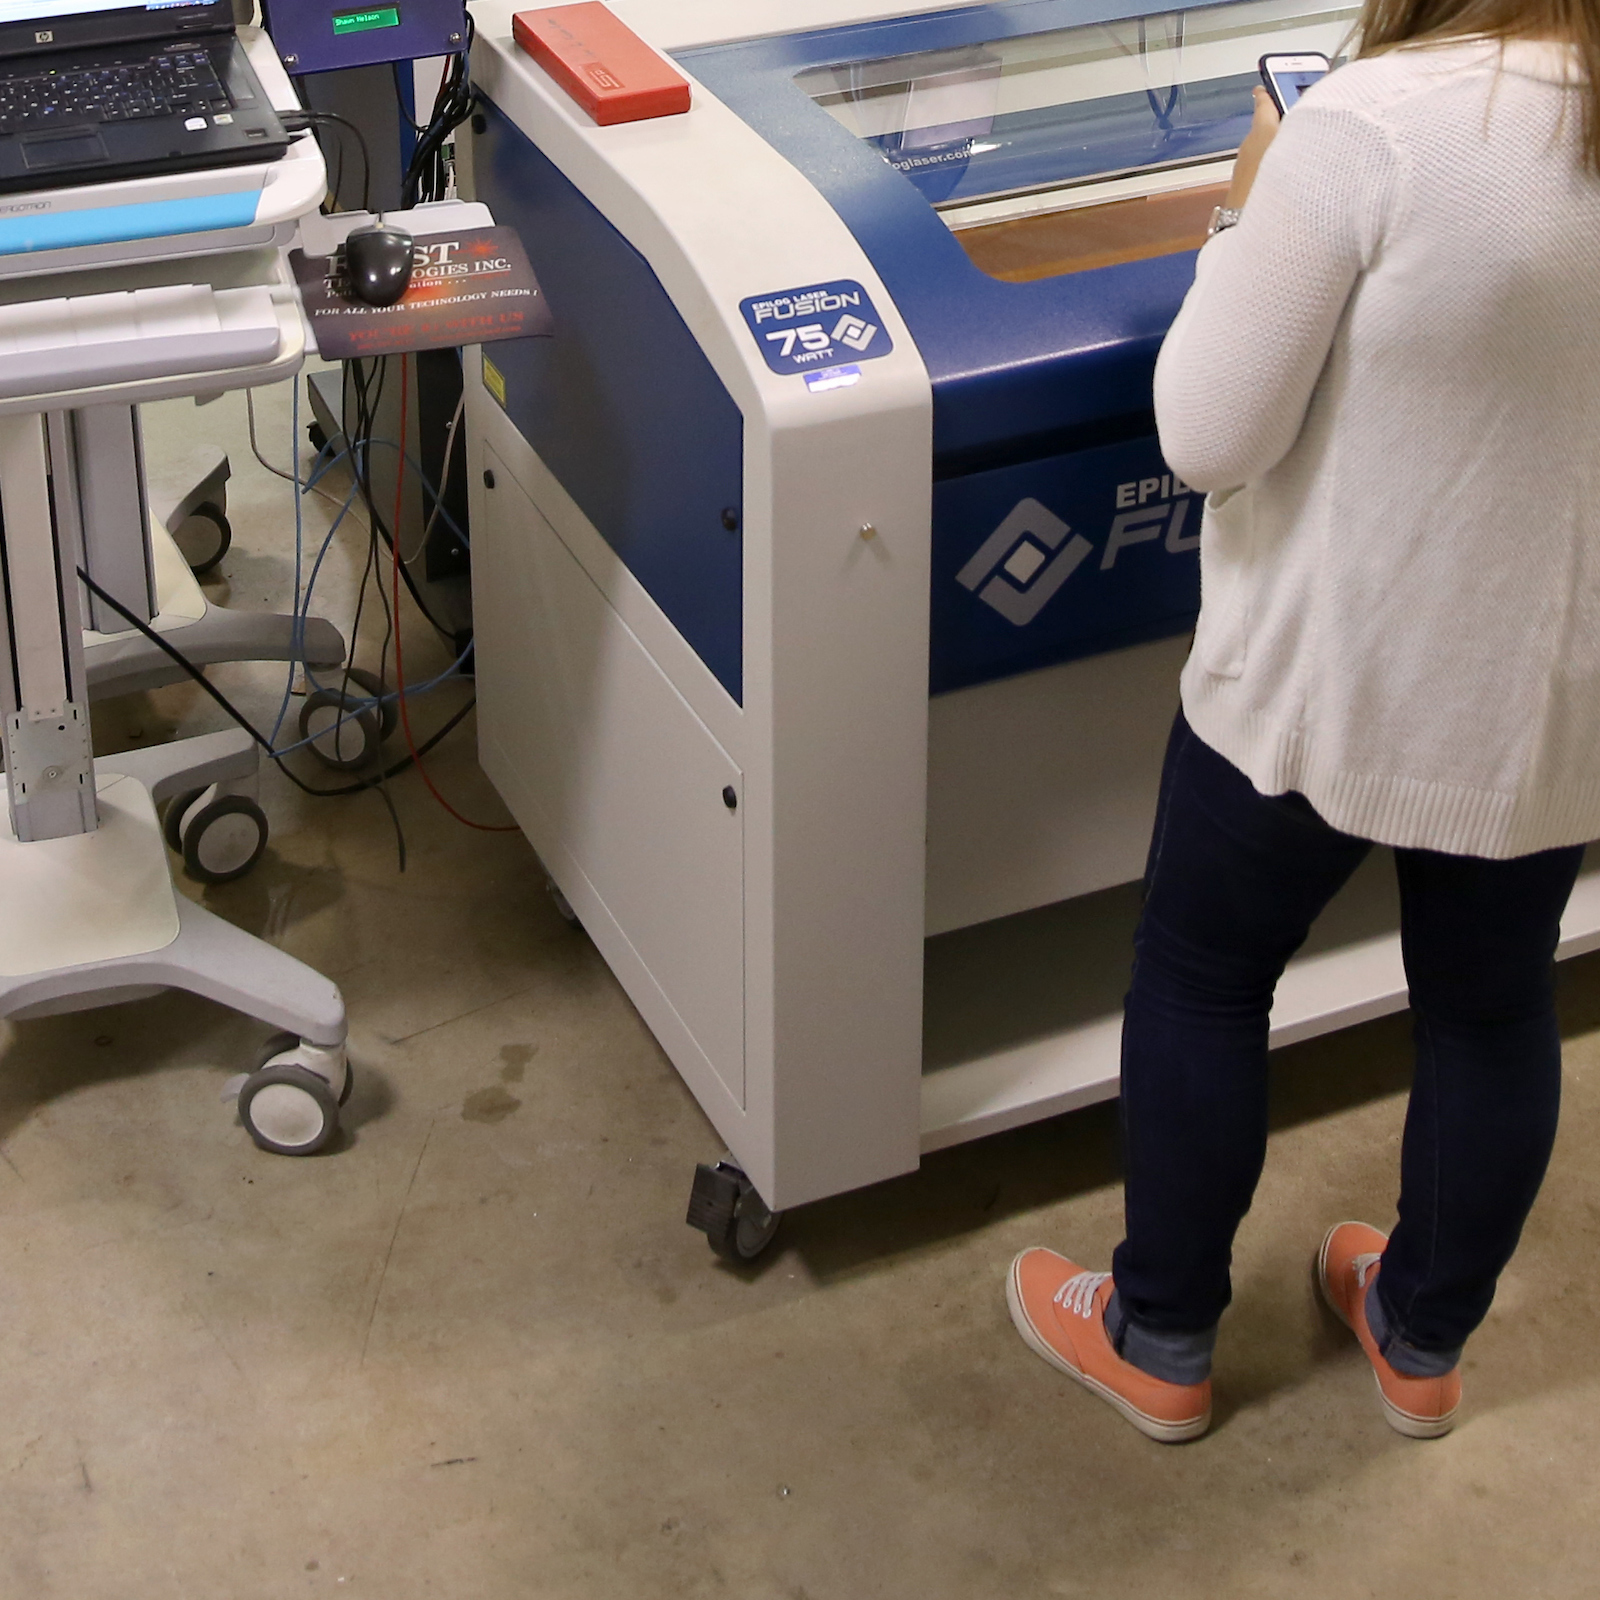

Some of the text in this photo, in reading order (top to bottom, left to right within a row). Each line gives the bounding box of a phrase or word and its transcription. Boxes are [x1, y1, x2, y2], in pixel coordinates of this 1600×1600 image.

[474, 257, 512, 272] INC.
[315, 307, 340, 317] FOR
[343, 306, 367, 315] ALL
[371, 303, 406, 314] YOUR
[409, 293, 488, 309] TECHNOLOGY
[490, 288, 531, 298] NEEDS
[751, 290, 829, 311] EPILOG LASER
[754, 291, 861, 324] FUSION
[765, 323, 831, 357] 75
[792, 347, 835, 364] WATT
